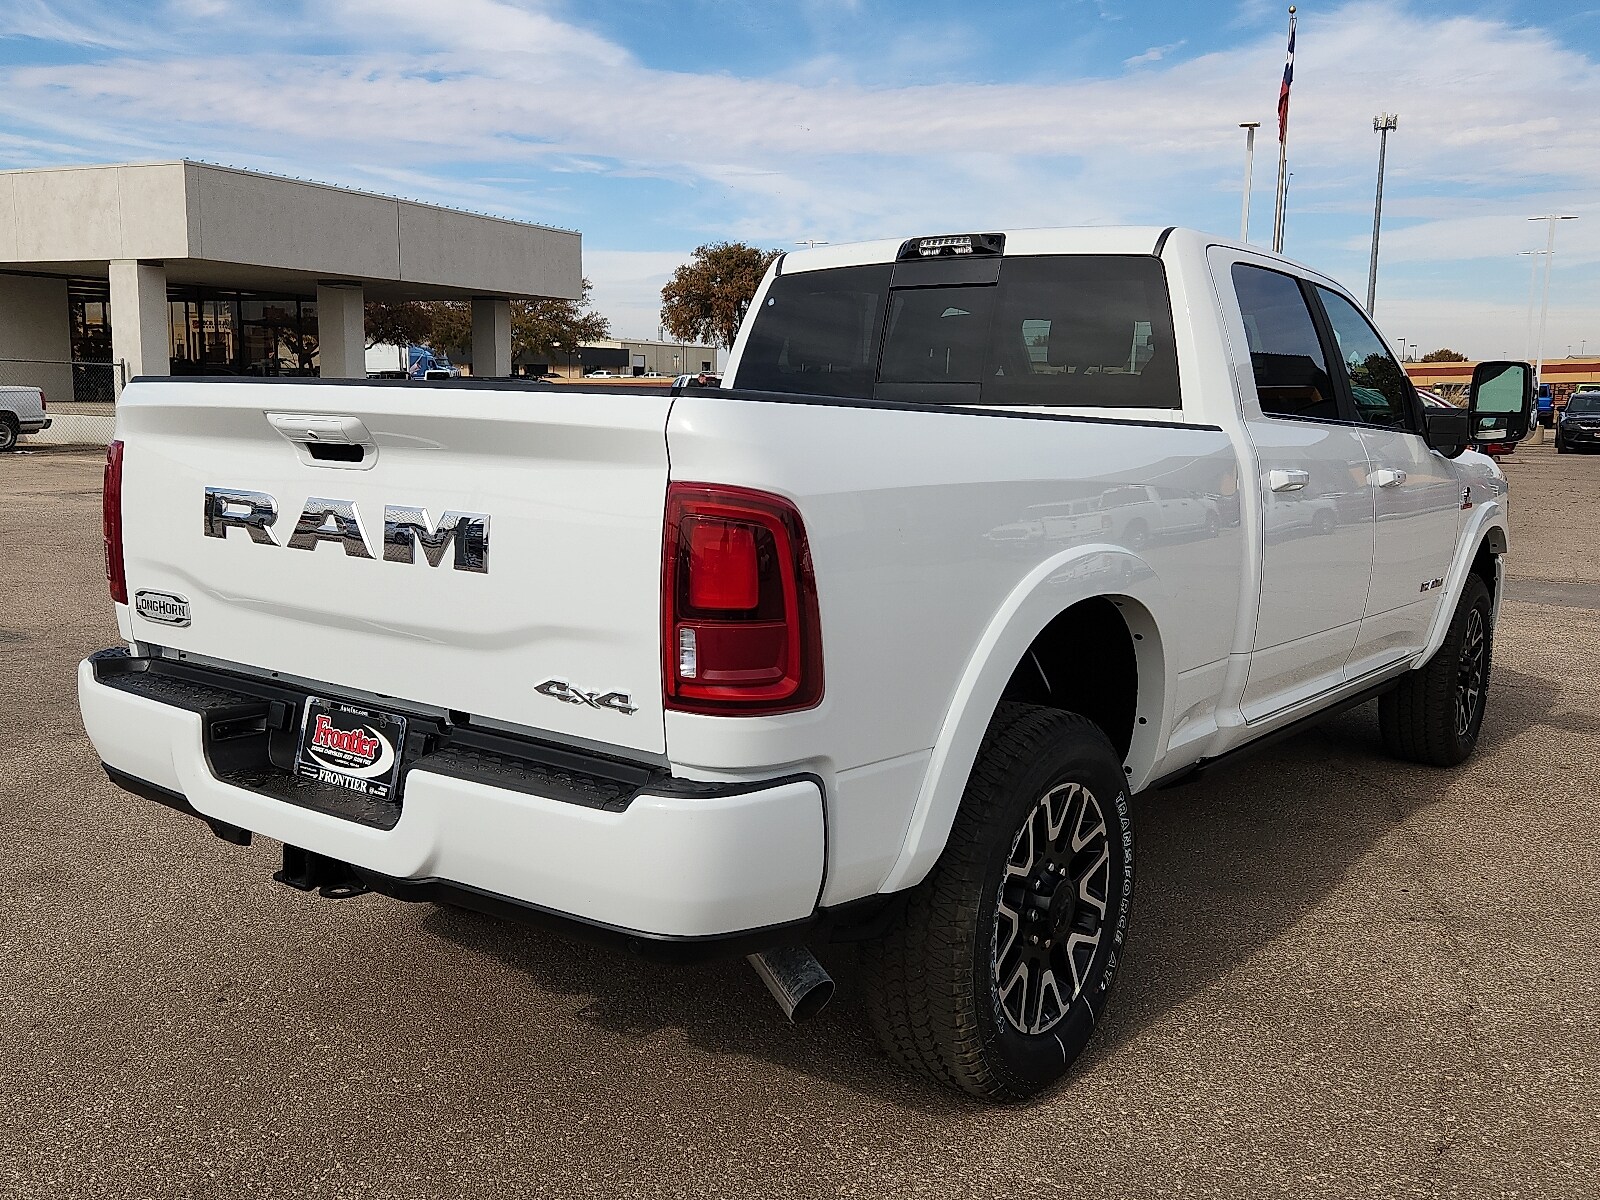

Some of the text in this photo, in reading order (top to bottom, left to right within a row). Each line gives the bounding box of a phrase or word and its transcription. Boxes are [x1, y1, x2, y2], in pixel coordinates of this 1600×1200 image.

[203, 486, 492, 574] RAM
[534, 677, 638, 716] 4x4
[312, 714, 379, 759] Frontier
[318, 768, 368, 793] FRONTIER
[1114, 790, 1132, 945] TRANSFORCE
